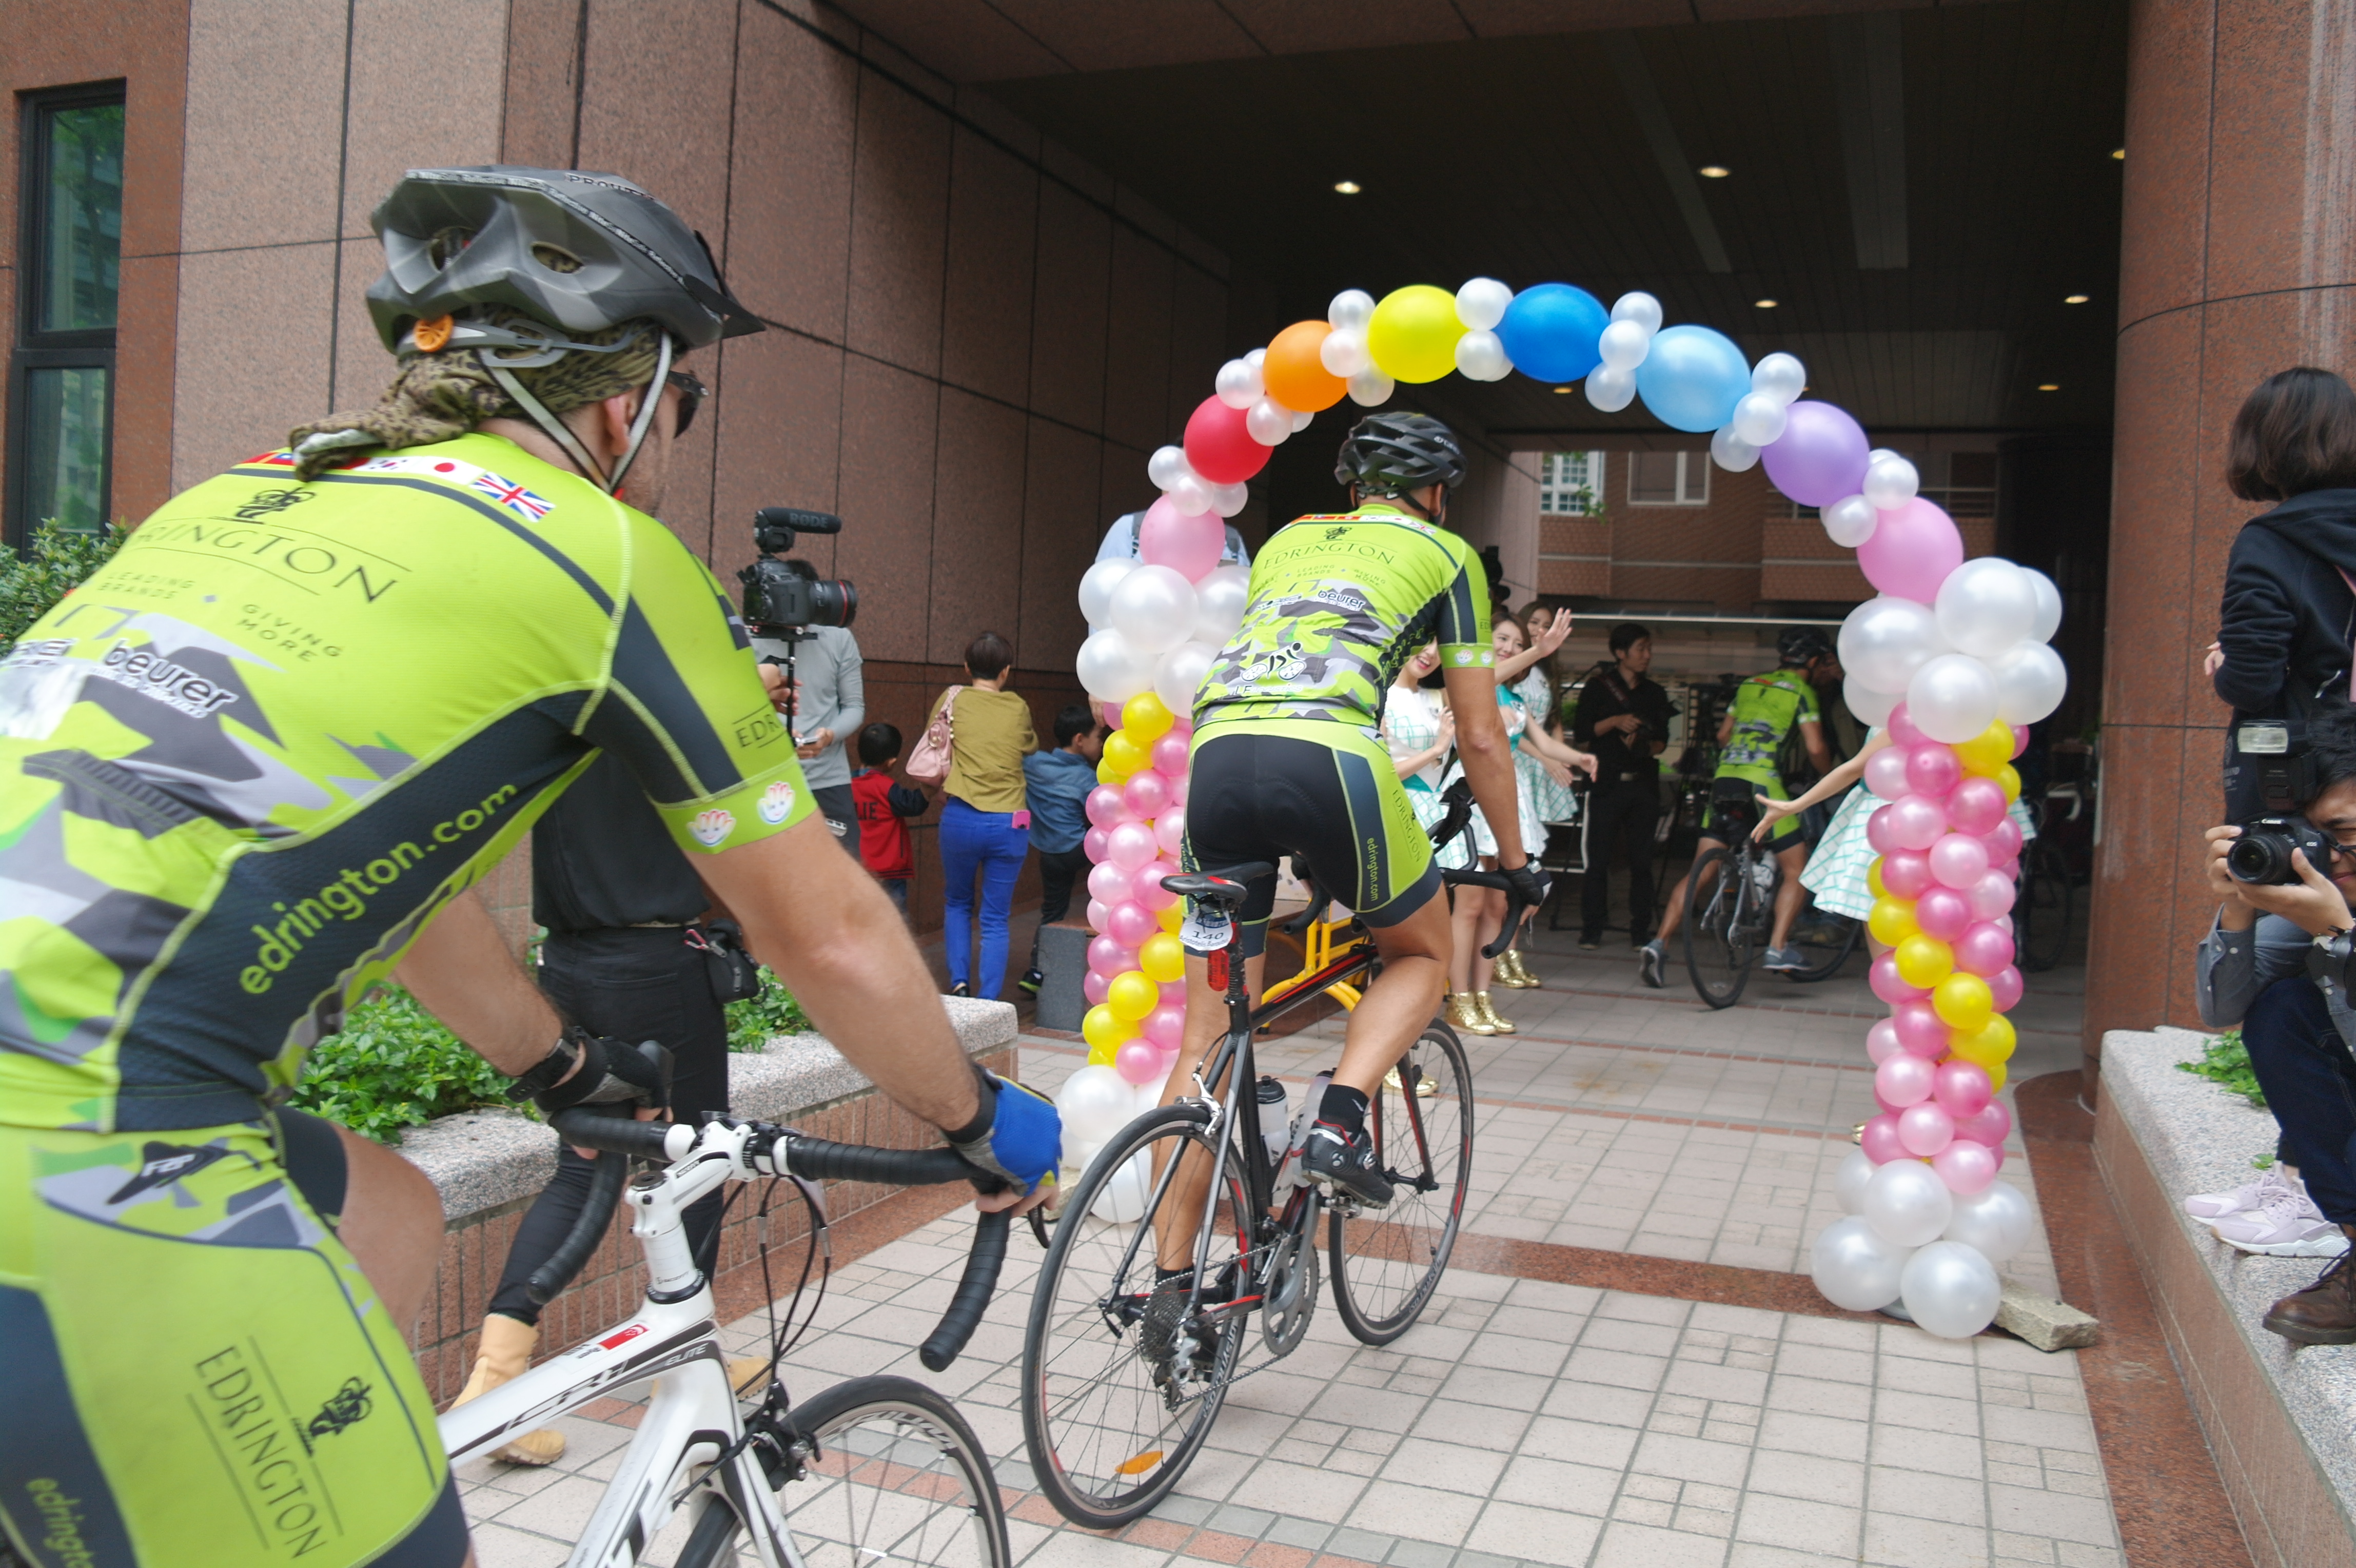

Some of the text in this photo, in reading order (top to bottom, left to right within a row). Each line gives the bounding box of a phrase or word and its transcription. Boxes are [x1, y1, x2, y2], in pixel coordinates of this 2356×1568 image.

[1264, 543, 1395, 570] EDRINGTON
[1297, 564, 1335, 573] LEADING
[107, 572, 197, 589] LEADING
[1297, 570, 1331, 578] BRANDS
[96, 582, 179, 600] BRANDS
[1317, 589, 1365, 609] beurer
[235, 618, 319, 662] MORE
[242, 604, 343, 657] GIVING
[104, 639, 234, 710] beurer
[1392, 789, 1422, 863] EDRINGTON
[1367, 837, 1379, 902] edrington.com
[238, 783, 518, 996] edrington.com
[1192, 930, 1224, 940] 140
[665, 1342, 710, 1366] ELITE
[194, 1344, 329, 1561] EDRINGTON
